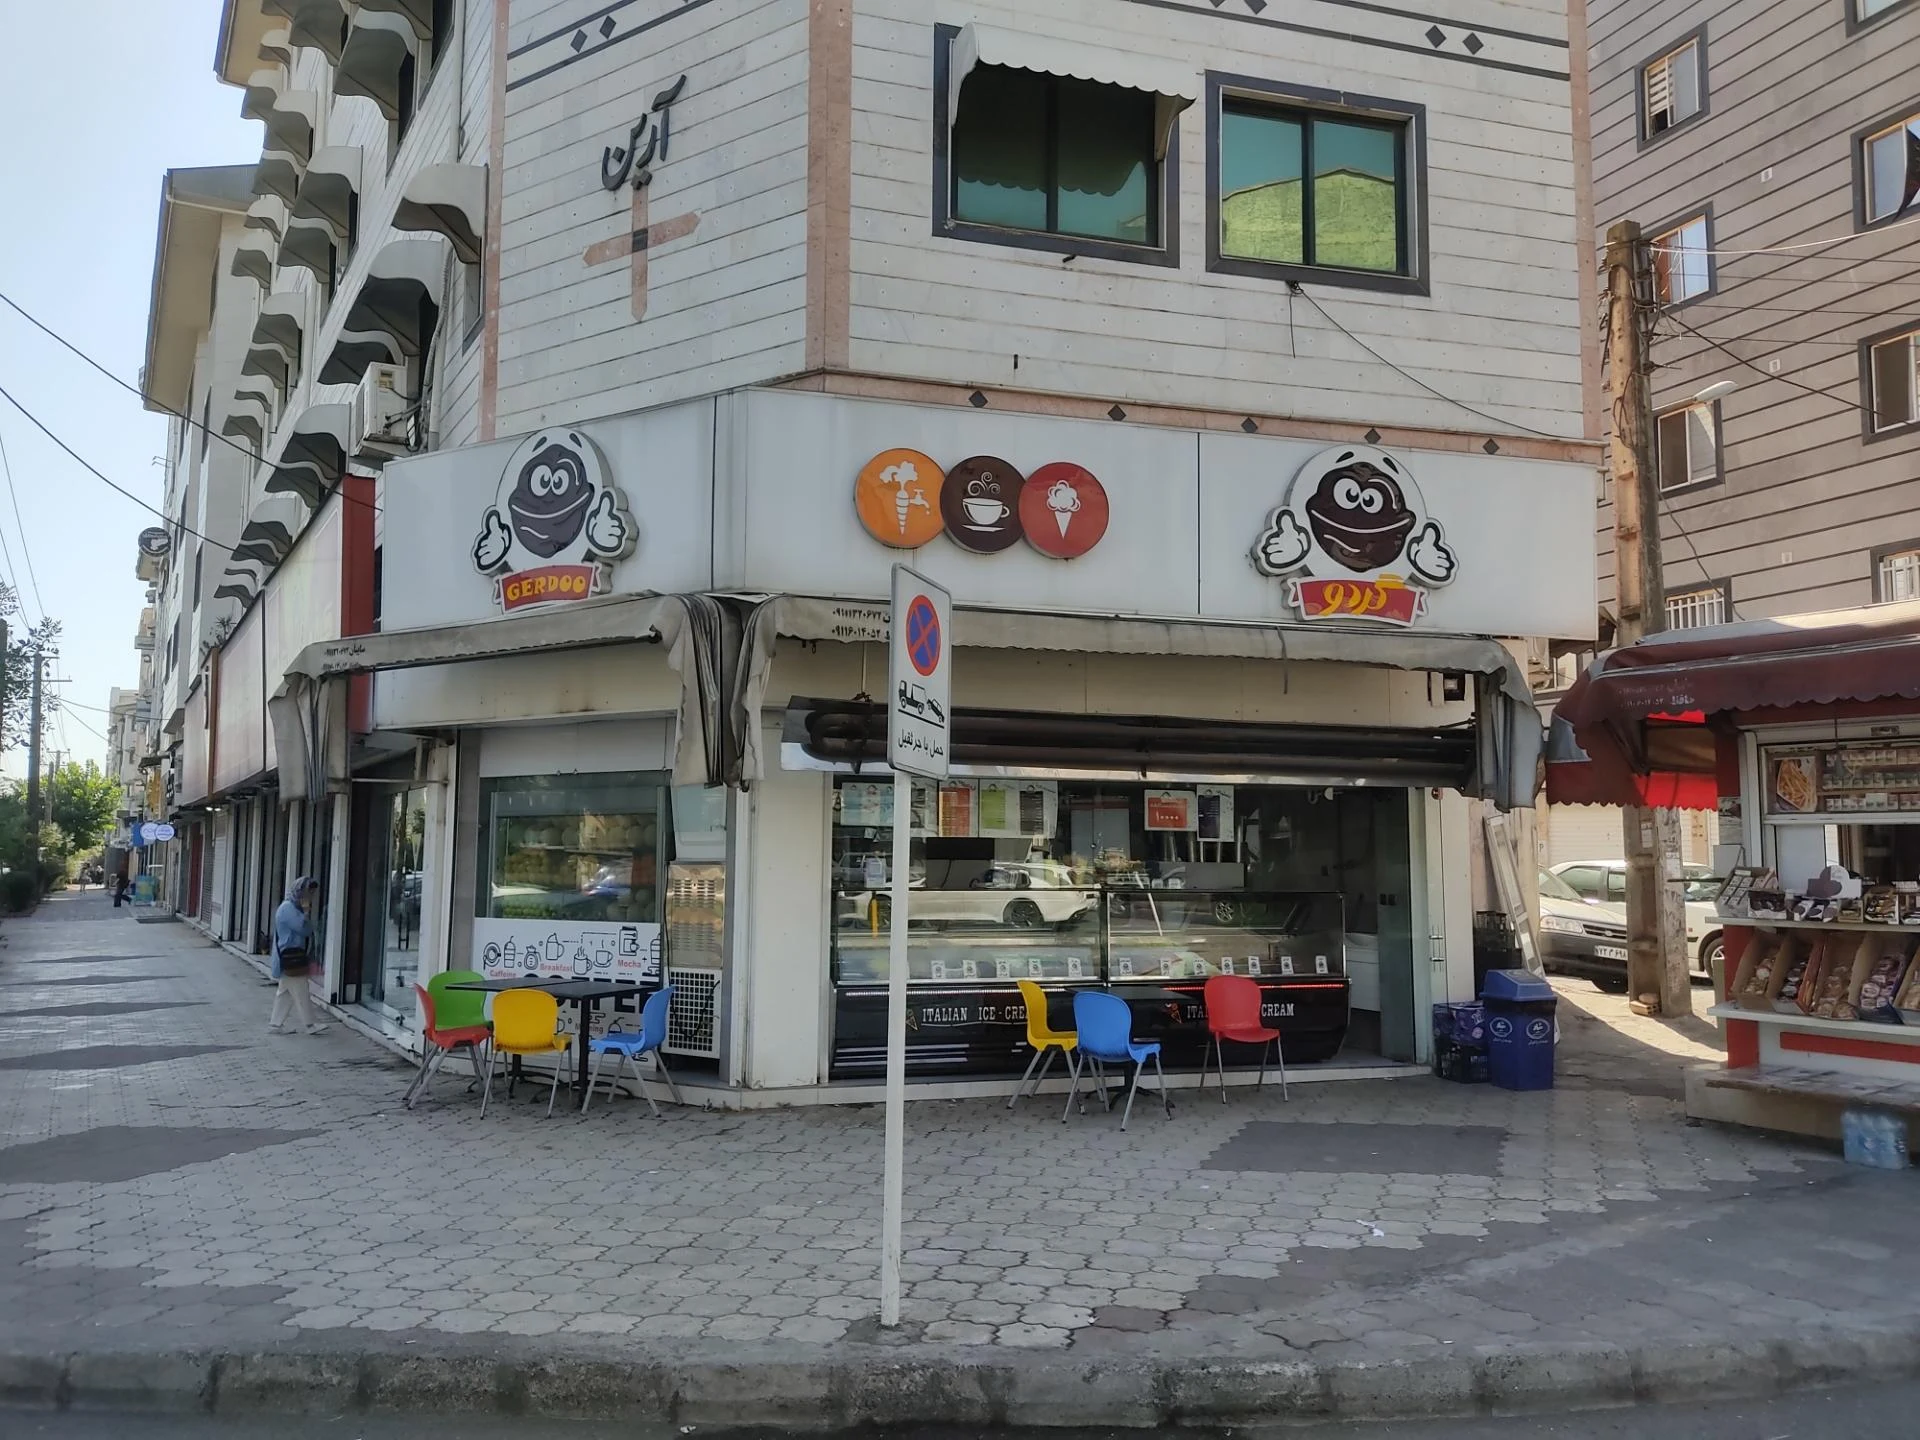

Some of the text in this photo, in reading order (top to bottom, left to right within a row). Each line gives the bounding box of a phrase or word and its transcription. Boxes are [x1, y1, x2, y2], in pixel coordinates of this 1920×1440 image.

[506, 575, 586, 600] GERDOO
[1320, 573, 1405, 616] گردو
[923, 736, 929, 755] با
[929, 739, 944, 758] حمل
[540, 963, 573, 972] Breakfast
[617, 959, 642, 968] Mocha
[923, 1008, 968, 1022] ITALIAN
[1261, 1003, 1294, 1017] CREAM
